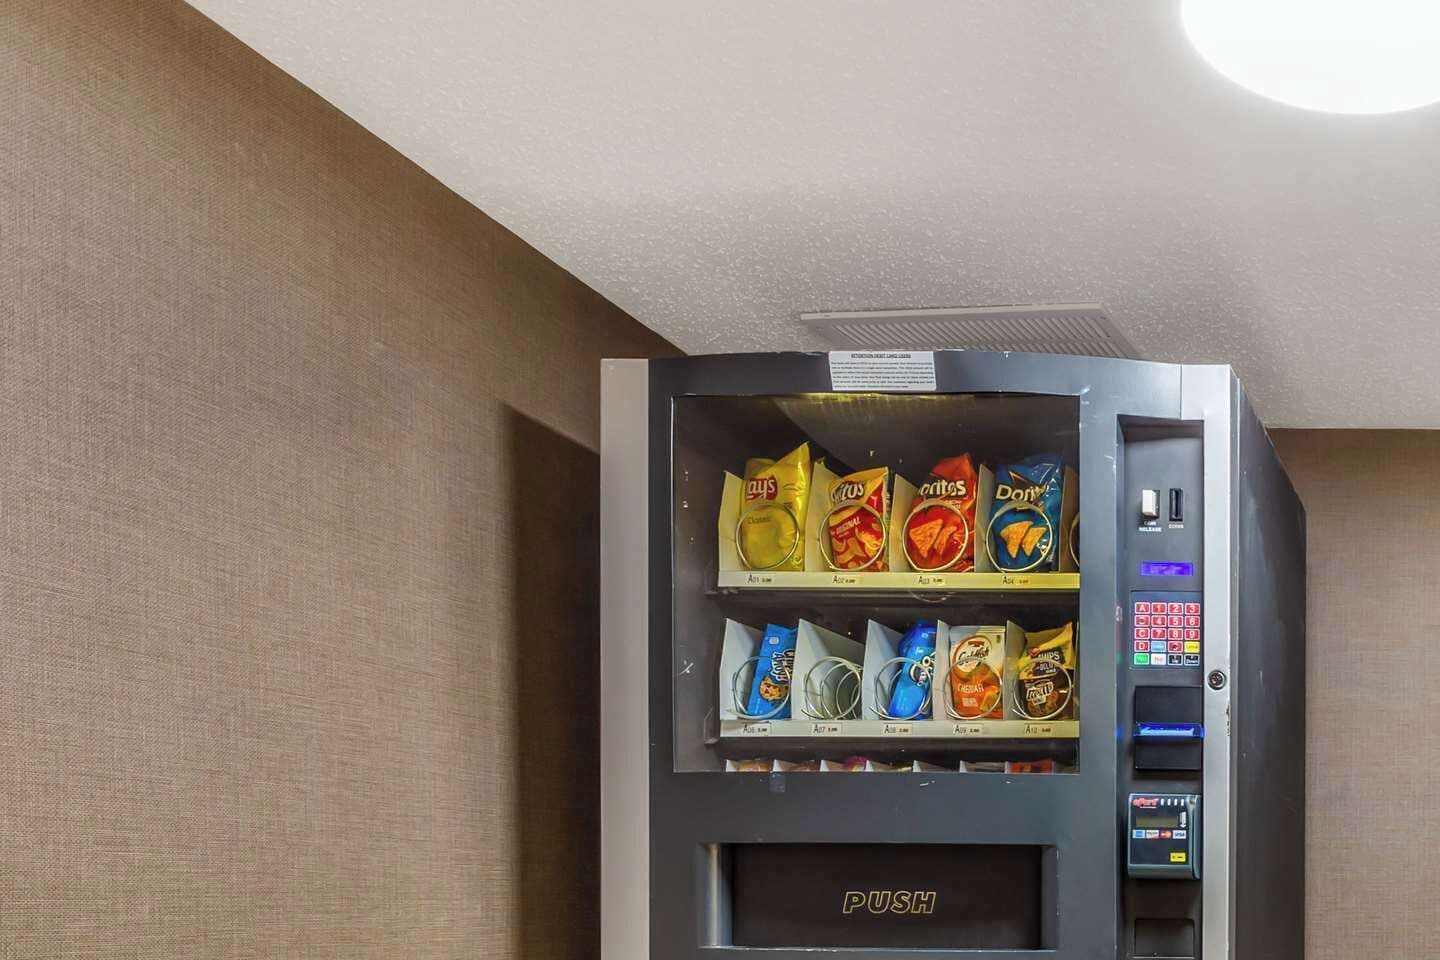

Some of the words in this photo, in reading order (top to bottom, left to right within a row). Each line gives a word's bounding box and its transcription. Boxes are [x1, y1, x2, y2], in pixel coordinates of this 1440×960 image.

[746, 478, 776, 500] ay's
[919, 479, 967, 498] oritos
[996, 484, 1049, 502] Dorit
[842, 890, 937, 914] PUSH
